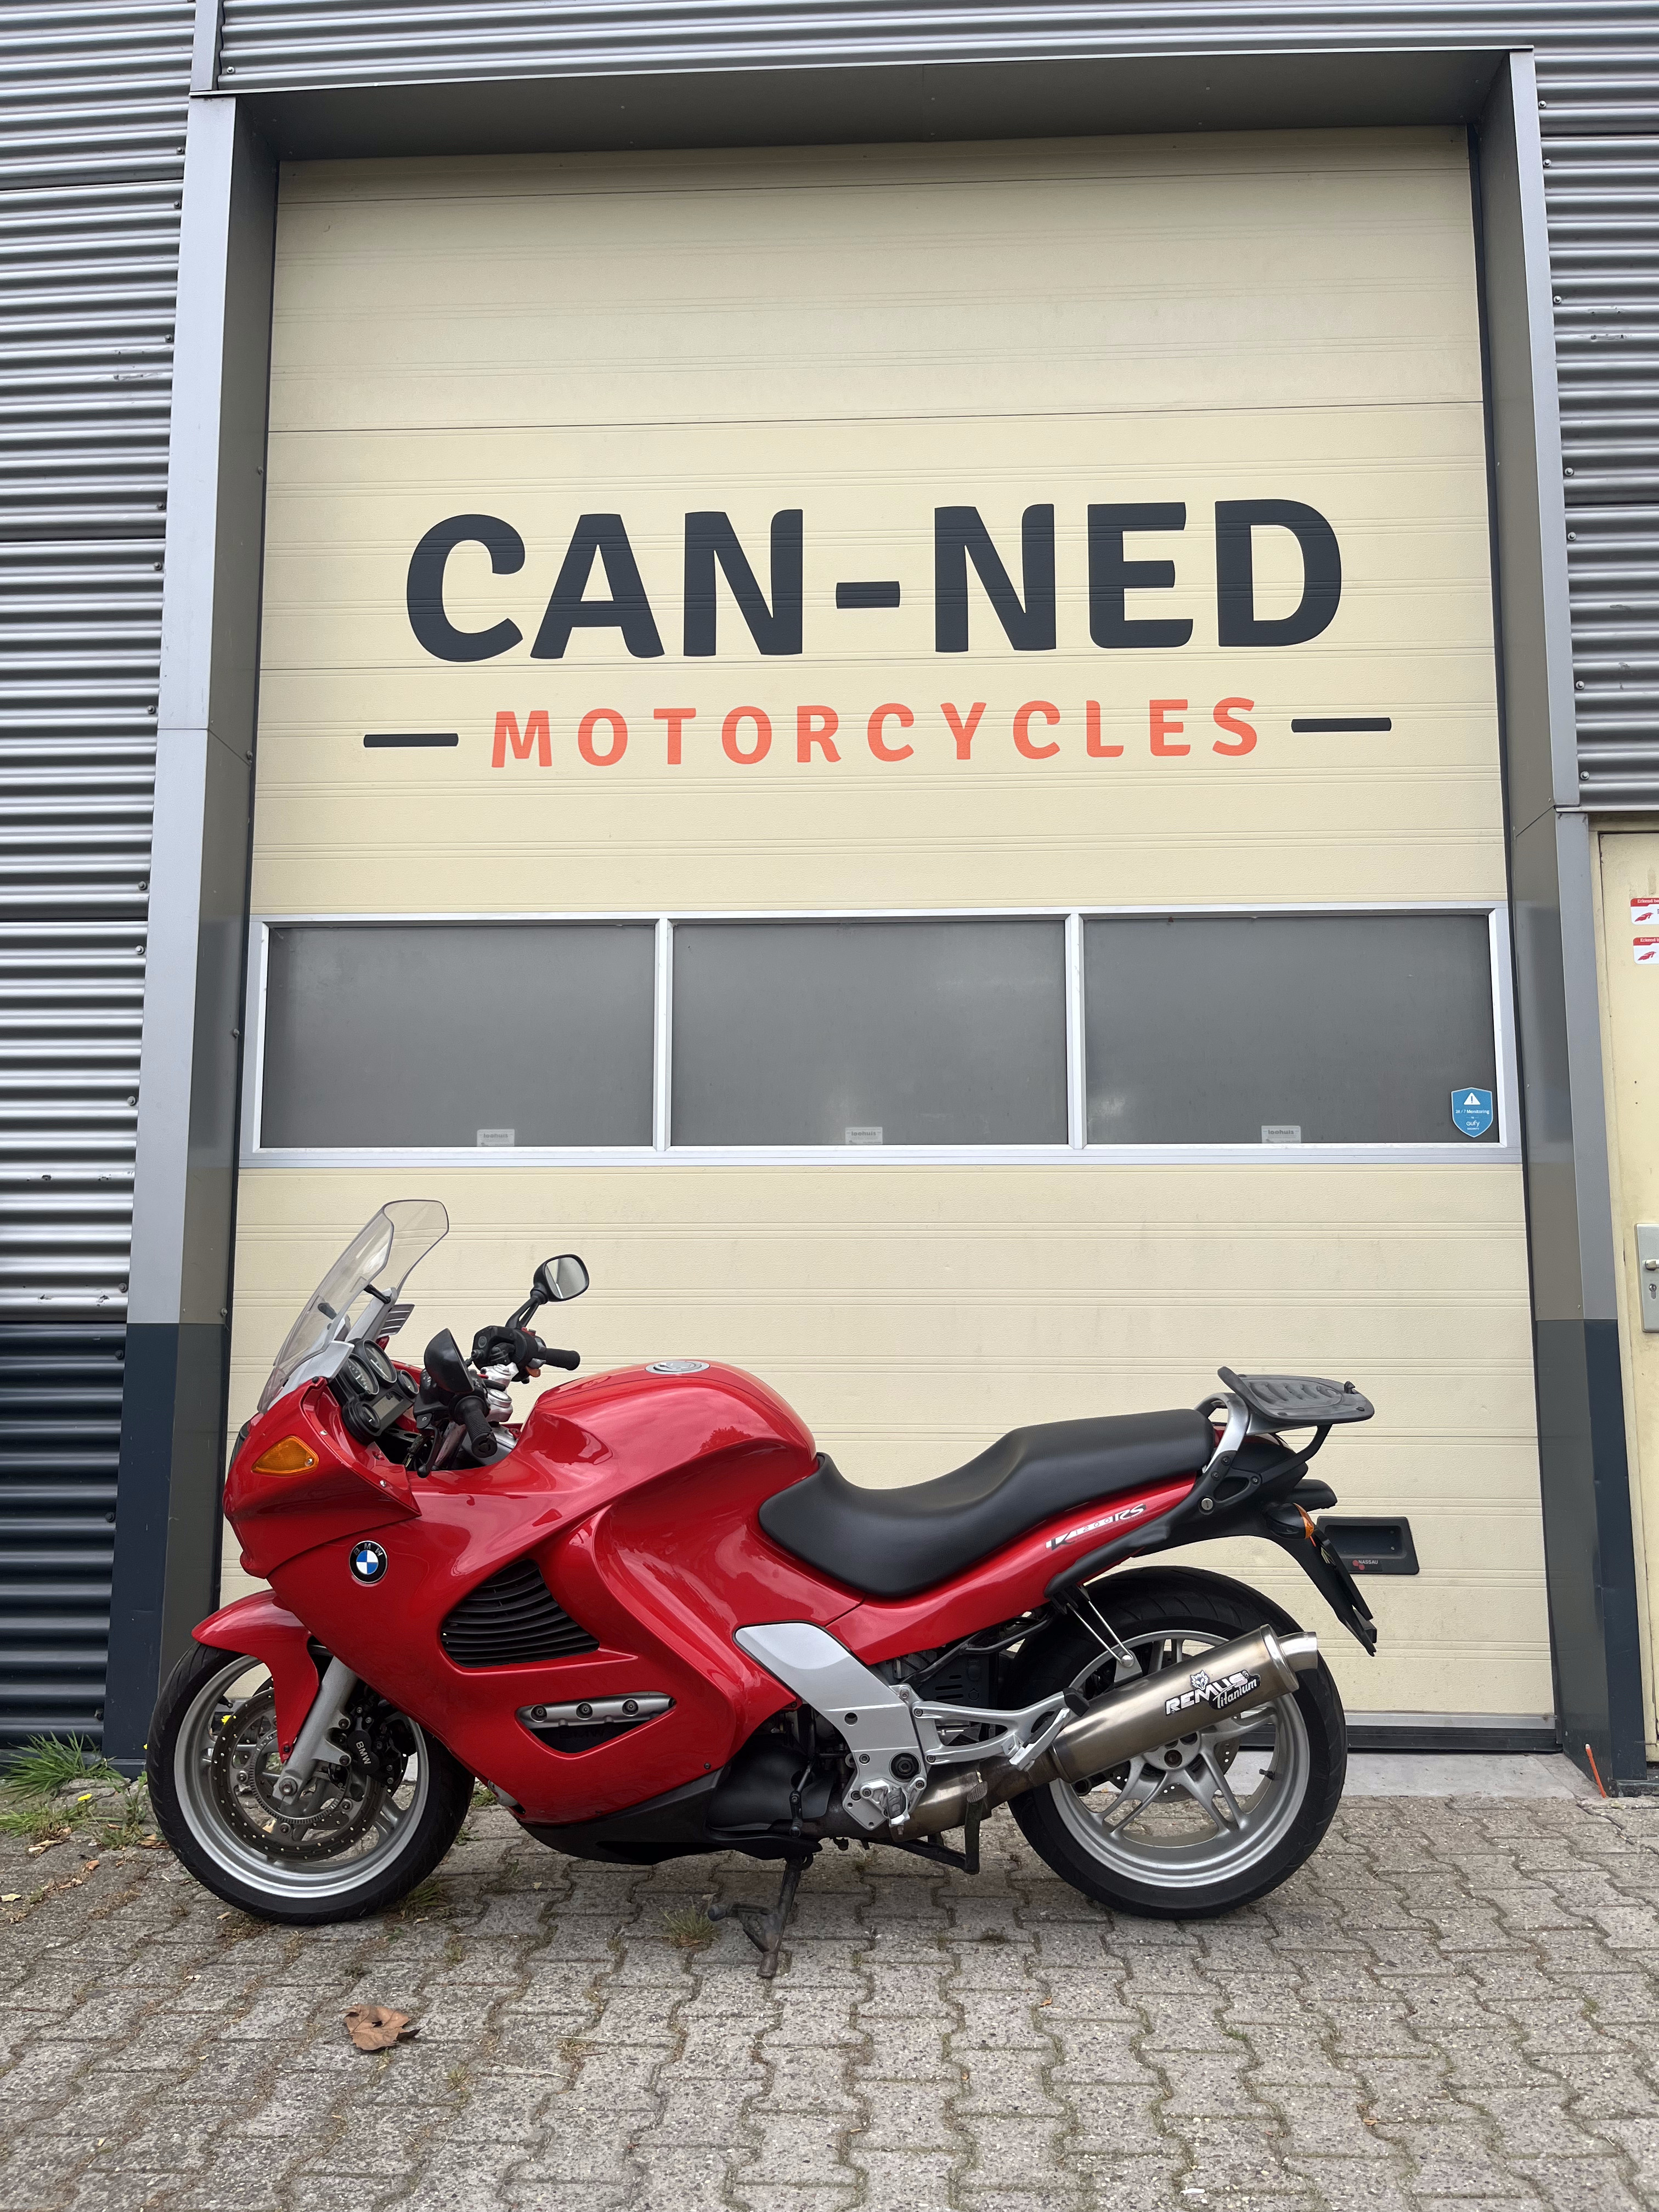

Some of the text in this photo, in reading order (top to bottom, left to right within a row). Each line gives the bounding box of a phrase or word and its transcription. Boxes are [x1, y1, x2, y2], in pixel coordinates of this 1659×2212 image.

[407, 499, 1342, 663] CAN-NED
[491, 697, 1257, 768] MOTORCYCLES
[353, 1543, 383, 1556] BMW
[1165, 1672, 1248, 1715] REMUS
[1212, 1679, 1257, 1709] Titanium
[356, 1741, 371, 1764] BMW
